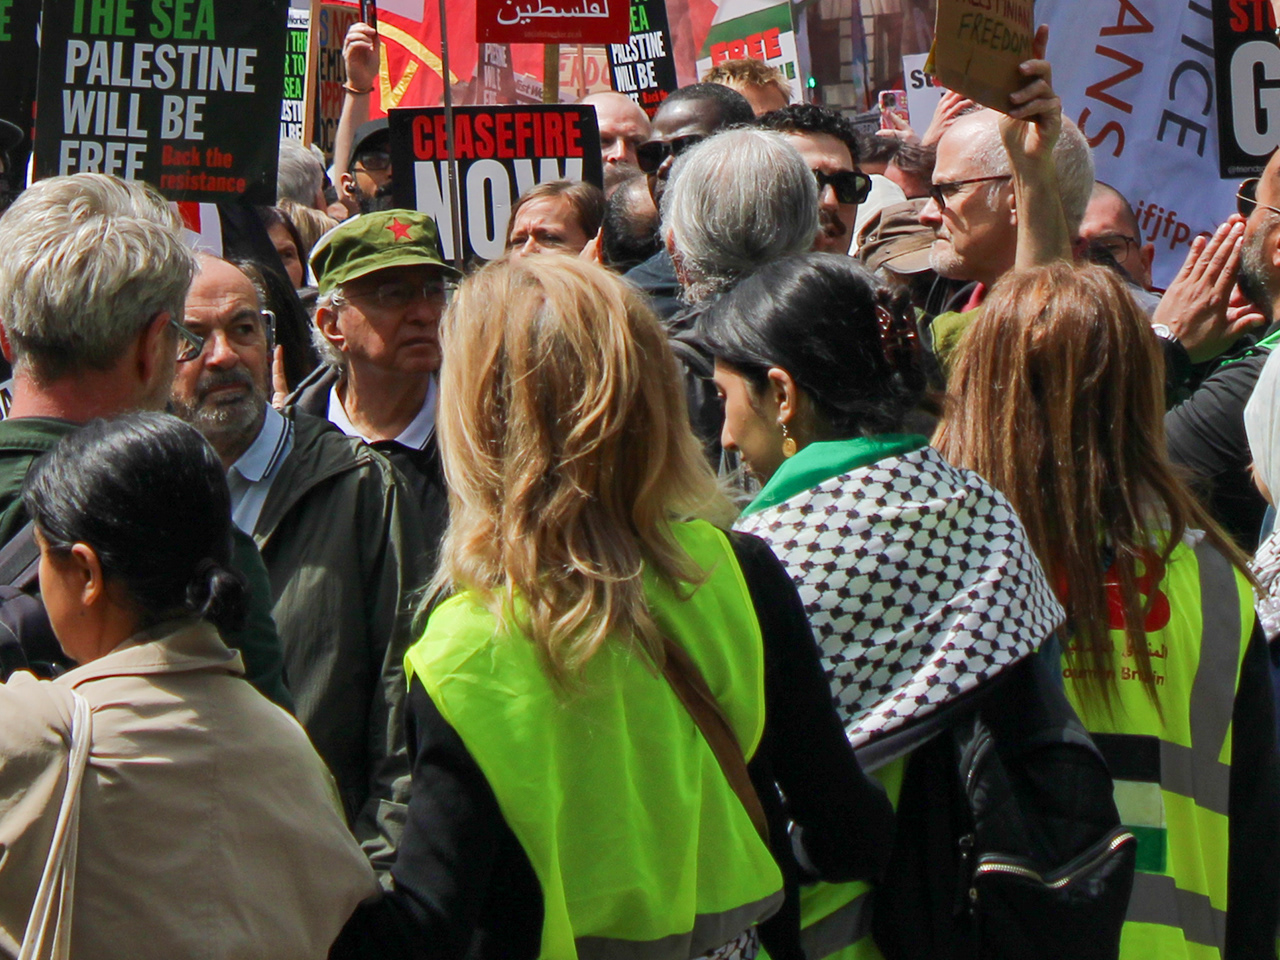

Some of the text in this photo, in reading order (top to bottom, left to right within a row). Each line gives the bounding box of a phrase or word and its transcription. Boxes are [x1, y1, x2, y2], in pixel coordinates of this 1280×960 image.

[958, 12, 1031, 55] FREEDOM
[64, 40, 258, 93] PALESTINE
[614, 60, 658, 92] WILL BE
[62, 90, 206, 141] WILL BE
[411, 111, 584, 160] CEASEFIRE
[58, 141, 148, 182] FREE
[161, 145, 233, 168] Back the
[160, 172, 247, 194] resistance
